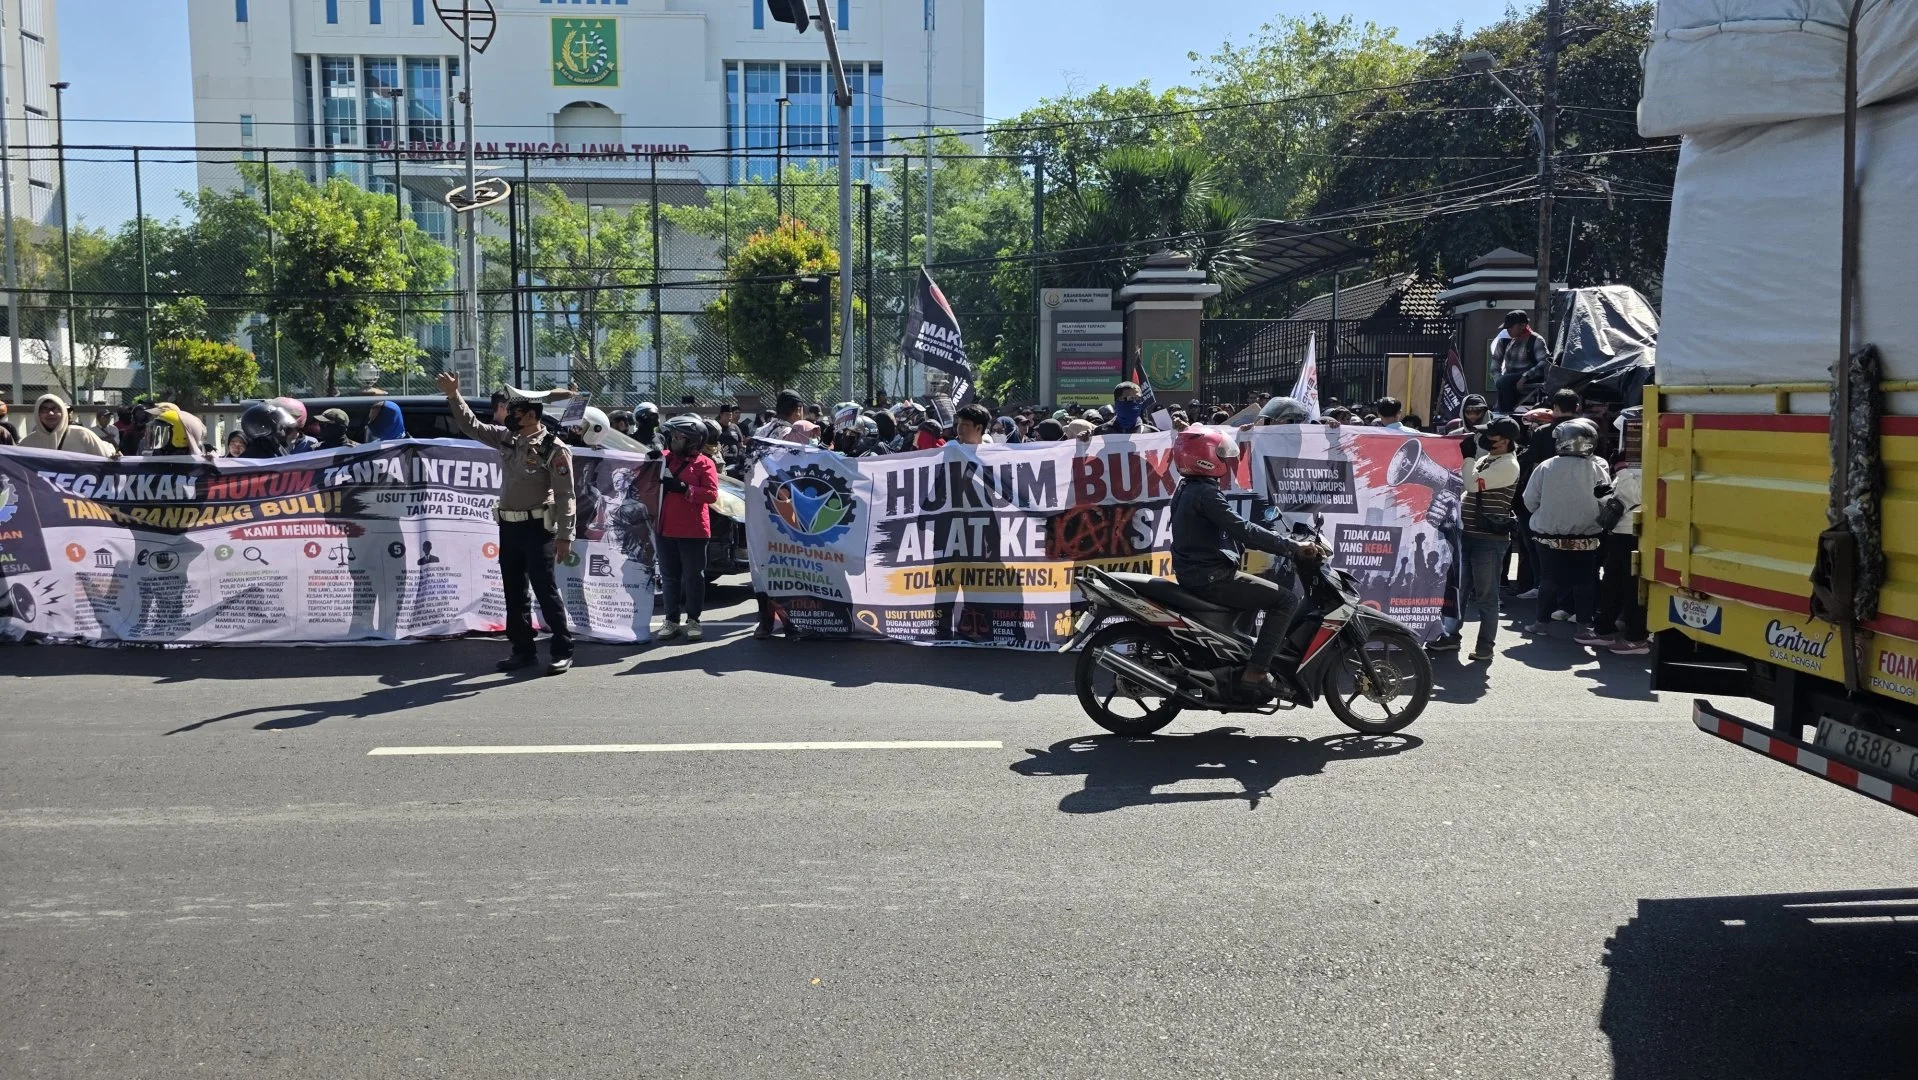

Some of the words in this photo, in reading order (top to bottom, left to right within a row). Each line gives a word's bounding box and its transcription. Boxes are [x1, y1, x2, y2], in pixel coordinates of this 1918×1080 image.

[379, 140, 498, 159] KEJAKSAAN
[505, 141, 570, 160] TINGGI
[577, 142, 627, 162] JAWA
[631, 143, 690, 162] TIMUR
[914, 340, 954, 361] KORWIL
[1198, 460, 1214, 468] INK
[37, 470, 198, 501] TEGAKKAN
[207, 470, 317, 500] HUKUM
[323, 457, 405, 488] TANPA
[412, 457, 502, 489] INTERV
[886, 460, 1058, 516] HUKUM
[1072, 441, 1253, 505] BUKN
[1282, 468, 1305, 479] USUT
[1306, 468, 1339, 480] TUNTAS
[1278, 480, 1312, 492] DUGAAN
[1312, 482, 1346, 492] KORUPSI
[376, 492, 406, 503] USUT
[410, 491, 454, 503] TUNTAS
[457, 495, 500, 509] DUGAA
[1273, 493, 1298, 504] TANPA
[1298, 494, 1332, 504] PANDANG
[1332, 494, 1354, 505] BULU!
[129, 503, 254, 529] PANDANG
[259, 490, 342, 518] BULU!
[406, 504, 443, 516] TANPA
[447, 505, 489, 520] TEBANG
[243, 524, 278, 538] KAMI
[1343, 530, 1370, 541] TIDAK
[1371, 530, 1391, 542] ADA
[896, 518, 990, 563] ALAT
[1339, 542, 1363, 553] YANG
[1364, 544, 1394, 554] KEBAL
[220, 548, 229, 557] 3
[308, 545, 316, 555] 4
[393, 544, 401, 554] 5
[487, 545, 494, 554] 6
[767, 541, 845, 563] HIMPUNAN
[768, 555, 824, 572] AKTIVIS
[1345, 556, 1383, 566] HUKUM!
[767, 568, 834, 585] MILENIAL
[904, 568, 955, 590] TOLAK
[960, 566, 1058, 589] INTERVENSI,
[768, 580, 844, 599] INDONESIA
[1390, 597, 1430, 606] PENEGAKAN
[790, 618, 823, 626] INTERVENSI
[885, 610, 908, 619] USUT
[910, 609, 943, 619] TUNTAS
[992, 610, 1018, 619] TIDAK
[1019, 610, 1037, 620] ADA
[912, 620, 940, 628] KORUPSI
[1764, 618, 1834, 660] Central
[1769, 649, 1789, 662] BUSA
[1790, 655, 1822, 672] DENGAN
[1878, 650, 1918, 682] FOAM
[1869, 675, 1915, 697] TEKNOLOGI
[1844, 730, 1893, 770] 8386
